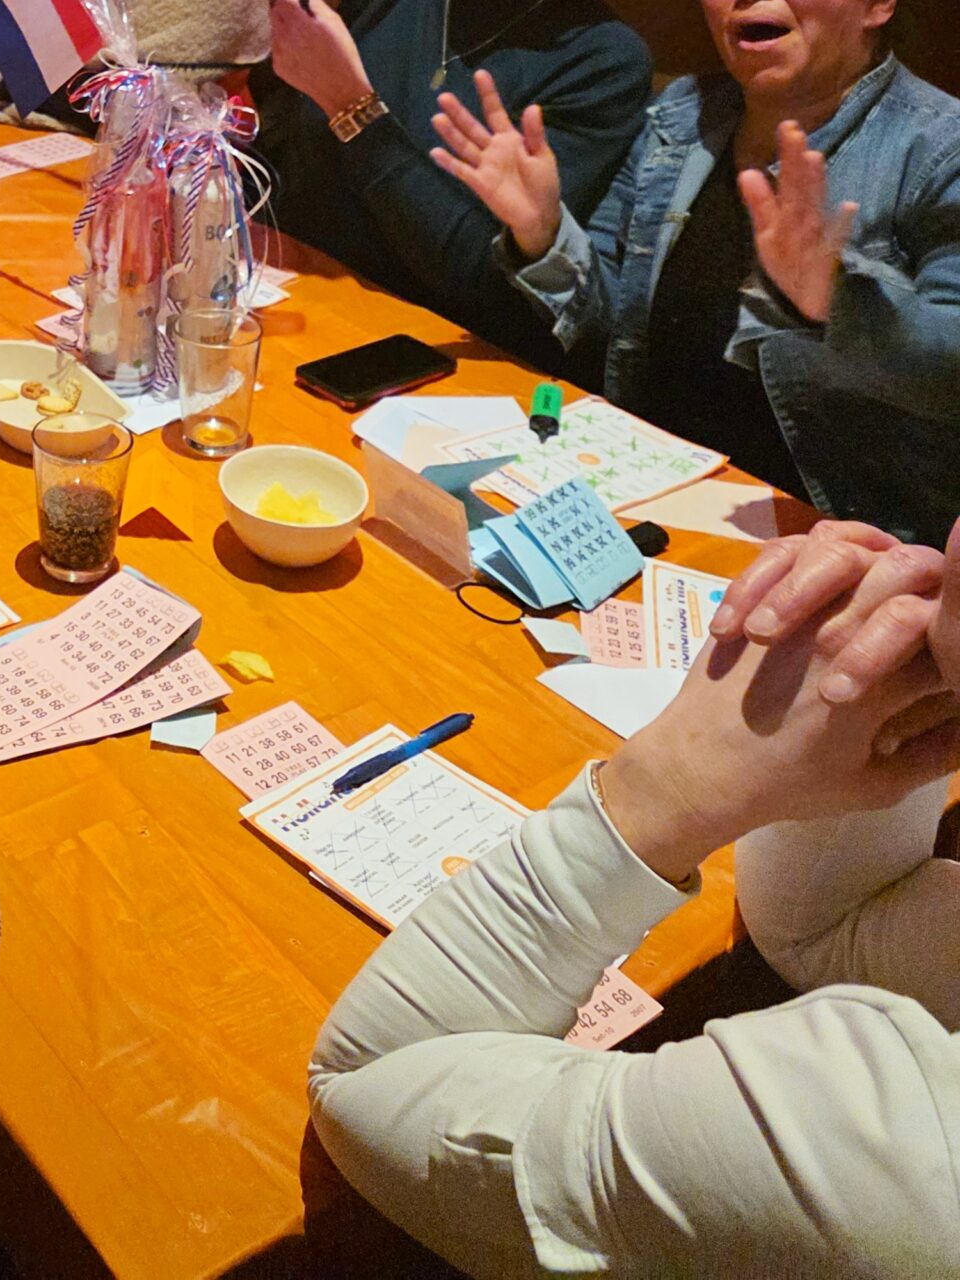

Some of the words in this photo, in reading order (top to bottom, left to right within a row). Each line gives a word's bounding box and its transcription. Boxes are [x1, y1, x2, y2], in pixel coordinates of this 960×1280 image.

[95, 600, 109, 610] 11
[106, 608, 121, 619] 27
[120, 618, 134, 629] 33
[132, 628, 147, 638] 50
[145, 636, 161, 647] 67
[110, 588, 124, 599] 13
[122, 598, 136, 608] 29
[136, 607, 148, 618] 45
[147, 615, 162, 626] 54
[160, 622, 175, 634] 73
[64, 622, 78, 632] 15
[75, 631, 90, 641] 30
[89, 641, 102, 651] 40
[101, 650, 115, 661] 51
[114, 660, 130, 672] 65
[81, 612, 91, 620] 3
[92, 620, 106, 630] 17
[118, 639, 132, 650] 47
[130, 649, 145, 660] 62
[60, 641, 74, 651] 19
[72, 651, 87, 662] 34
[98, 672, 113, 684] 72
[6, 685, 21, 696] 39
[20, 697, 34, 707] 49
[32, 708, 47, 718] 69
[12, 666, 26, 677] 18
[24, 678, 38, 688] 41
[36, 689, 52, 699] 58
[49, 699, 65, 710] 66
[120, 694, 135, 704] 51
[158, 681, 173, 691] 59
[169, 692, 183, 704] 70
[177, 674, 193, 684] 55
[188, 685, 203, 696] 63
[1, 704, 17, 715] 60
[14, 715, 30, 727] 74
[109, 713, 125, 724] 65
[149, 700, 164, 712] 73
[52, 727, 67, 738] 74
[225, 753, 240, 764] 11
[241, 745, 258, 757] 21
[259, 738, 276, 749] 38
[276, 730, 293, 741] 58
[293, 722, 308, 734] 61
[243, 767, 253, 776] 6
[256, 758, 273, 770] 28
[274, 750, 290, 761] 40
[291, 743, 307, 754] 60
[307, 734, 323, 747] 67
[255, 780, 272, 790] 12
[271, 772, 288, 784] 20
[306, 756, 321, 768] 57
[580, 1013, 597, 1029] 42
[594, 1001, 615, 1017] 54
[612, 989, 632, 1005] 68
